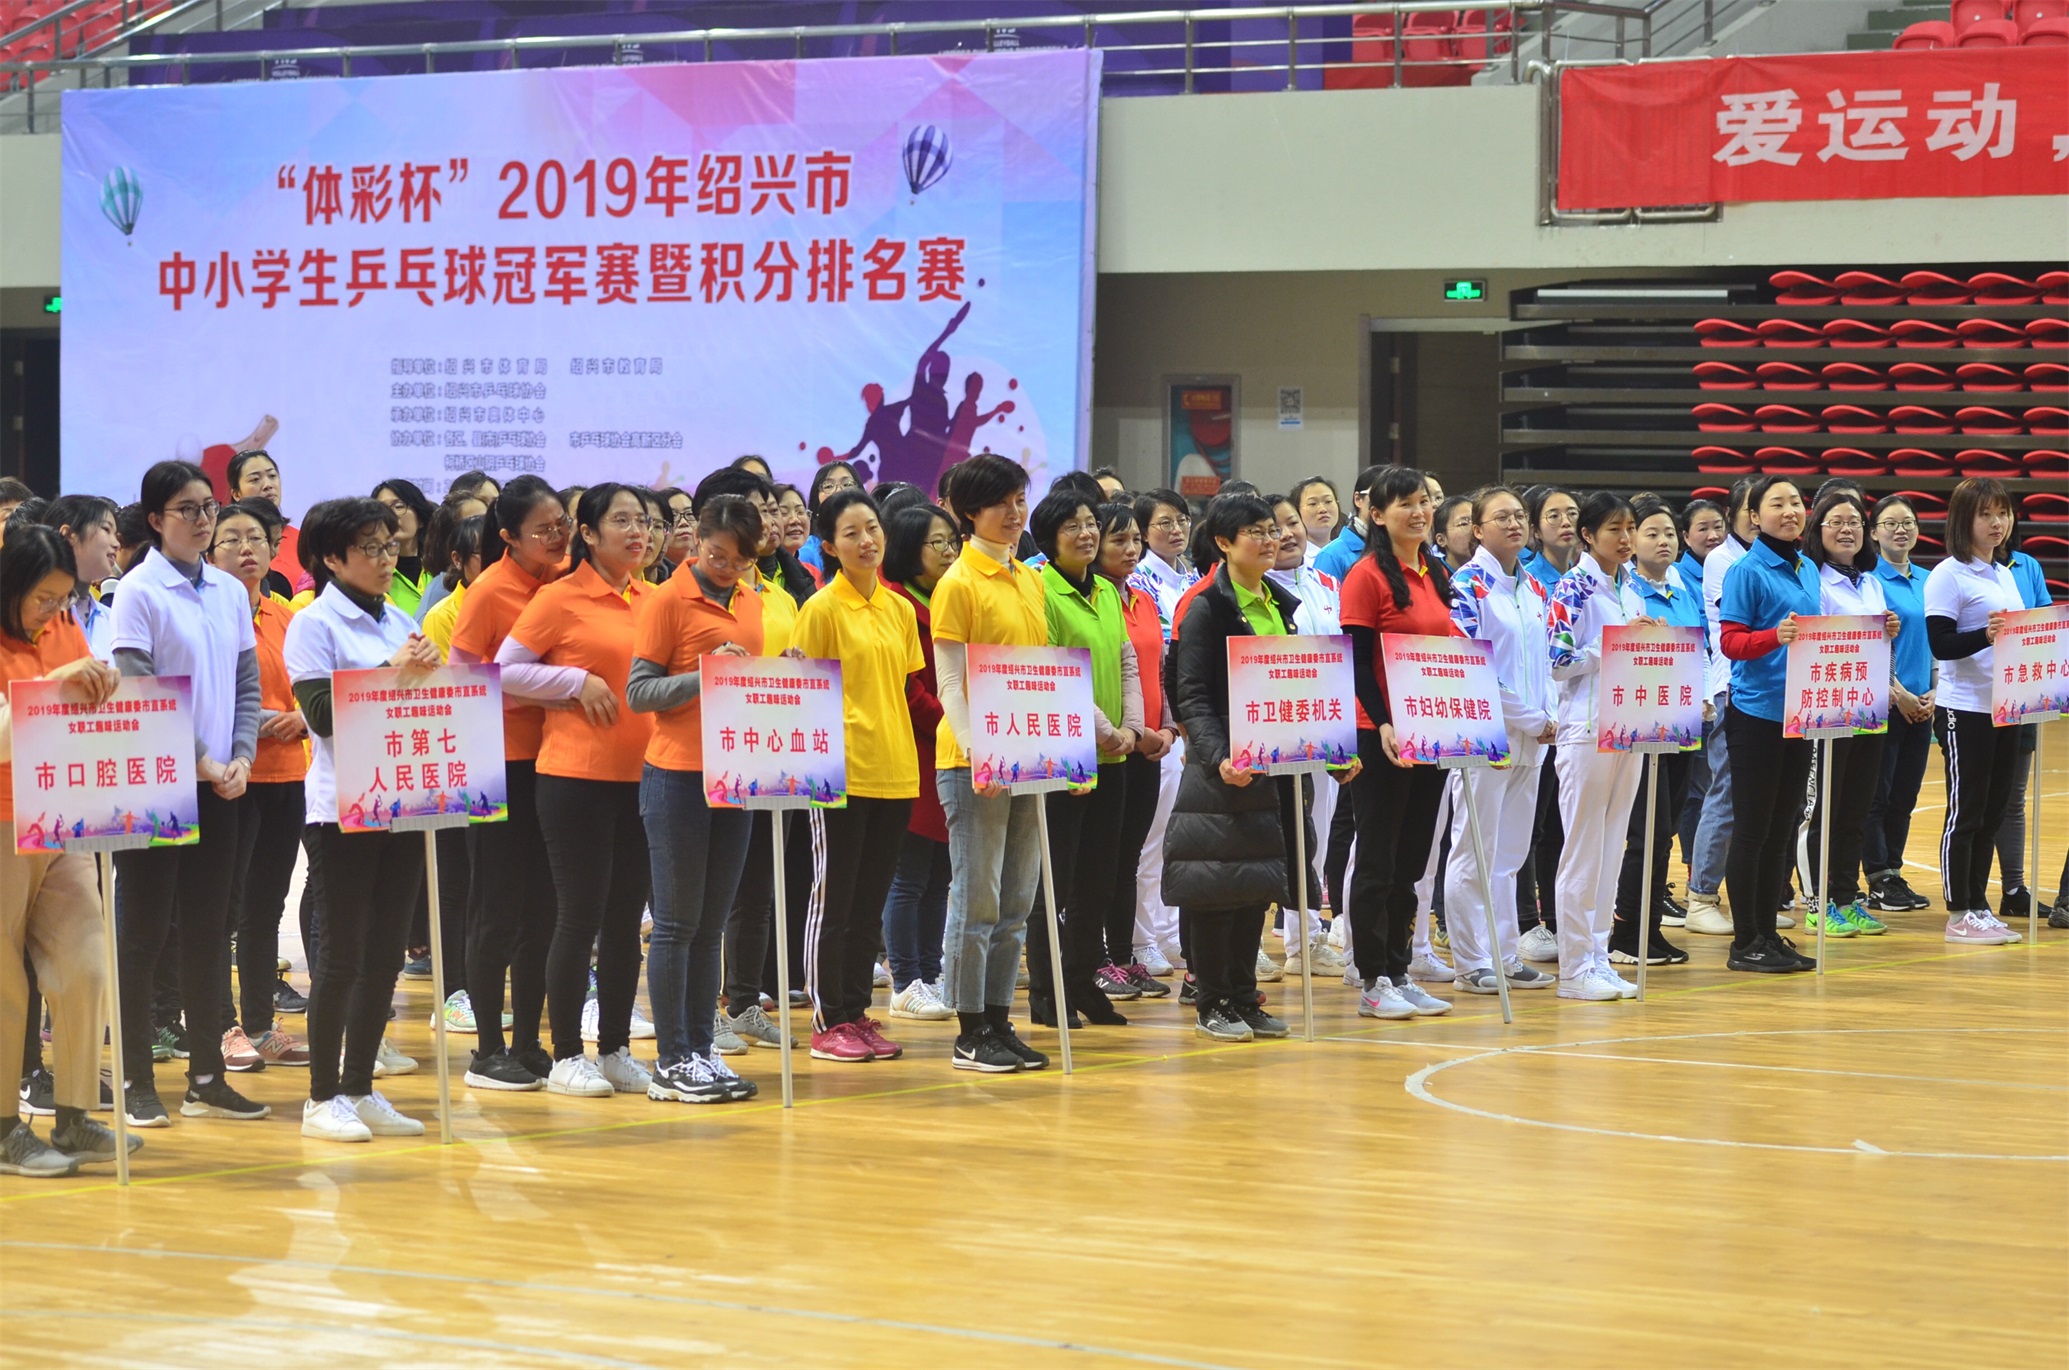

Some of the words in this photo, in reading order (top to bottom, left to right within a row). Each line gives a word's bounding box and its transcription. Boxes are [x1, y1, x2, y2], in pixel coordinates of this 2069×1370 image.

[159, 237, 966, 312] 中小学生乒乓球冠军赛暨积分排名赛
[570, 357, 663, 375] 绍兴市教育局
[714, 676, 831, 691] 2019年度绍兴市卫生健康委市直系统
[1810, 661, 1868, 683] 市疾病预
[2003, 658, 2069, 685] 市急救中心
[348, 684, 488, 703] 2019年度绍兴市卫生健康委市直系统
[745, 692, 801, 705] 女职工趣味运动会
[1612, 684, 1692, 707] 市中医院
[1801, 686, 1875, 709] 防控制中心
[385, 704, 453, 719] 女职工趣味运动会
[1245, 698, 1343, 724] 市卫健委机关
[1404, 695, 1492, 721] 市妇幼保健院
[68, 719, 140, 735] 女职工趣味运动会
[984, 711, 1083, 738] 市人民医院
[384, 728, 457, 758] 市第七
[719, 726, 830, 754] 市中心血站
[35, 755, 178, 791] 市口腔医院
[368, 760, 468, 793] 人民医院
